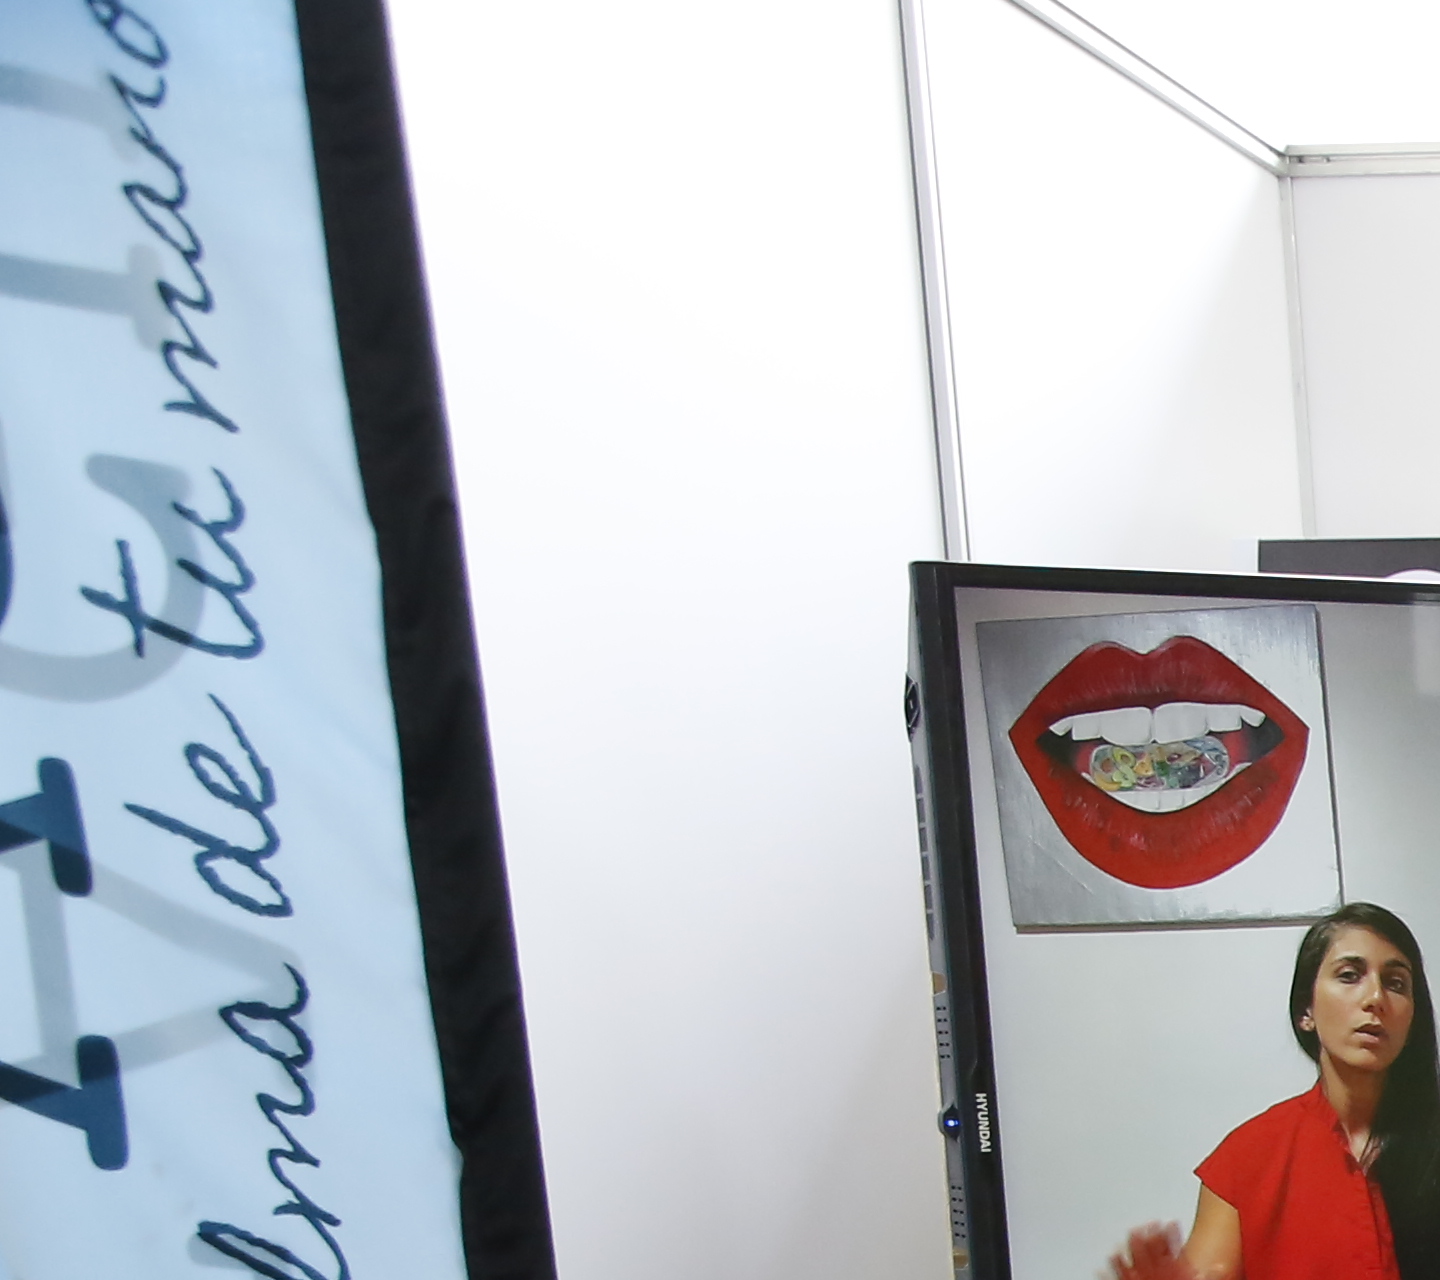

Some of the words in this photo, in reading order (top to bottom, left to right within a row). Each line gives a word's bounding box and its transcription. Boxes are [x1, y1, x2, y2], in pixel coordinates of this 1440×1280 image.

[84, 0, 239, 433] mano
[81, 468, 264, 660] tu
[125, 693, 292, 917] de
[975, 1092, 992, 1153] HYUNDAI
